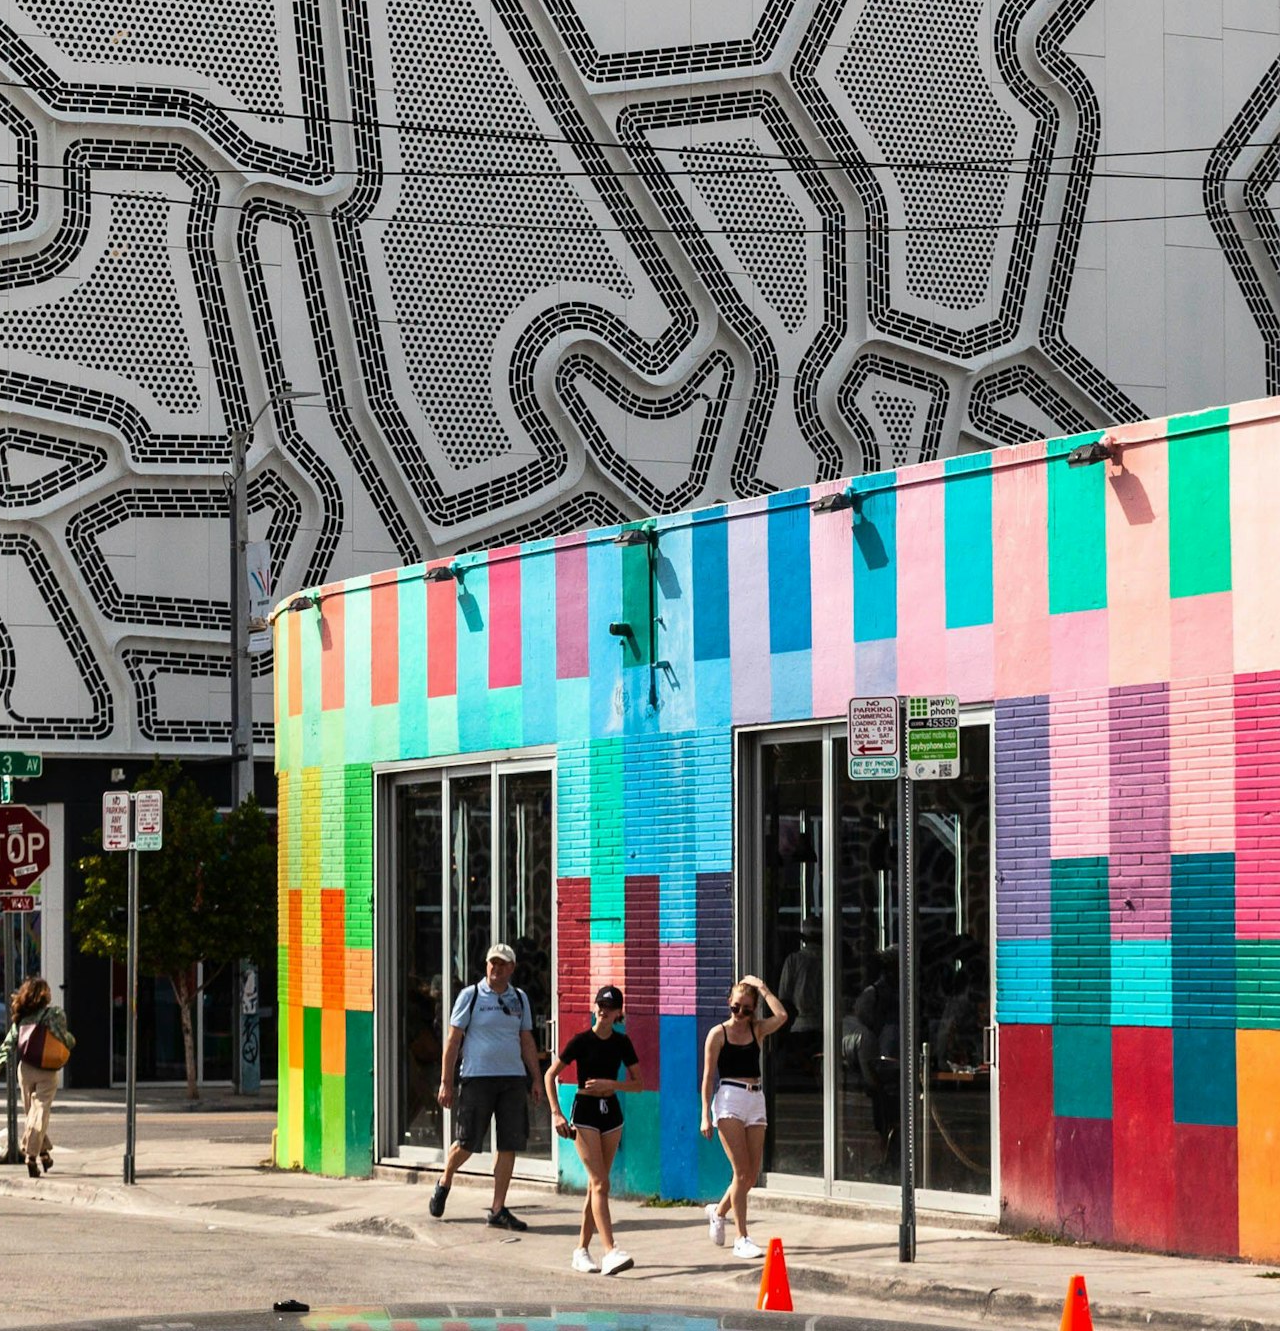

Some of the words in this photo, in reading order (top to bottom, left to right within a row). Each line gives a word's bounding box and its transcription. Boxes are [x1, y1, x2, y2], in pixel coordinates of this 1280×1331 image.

[930, 708, 956, 717] phone
[926, 717, 956, 728] 45359
[2, 755, 13, 774] 3
[26, 758, 39, 771] AV
[112, 796, 121, 806] NO
[110, 825, 122, 834] TIME
[11, 897, 32, 910] WAY
